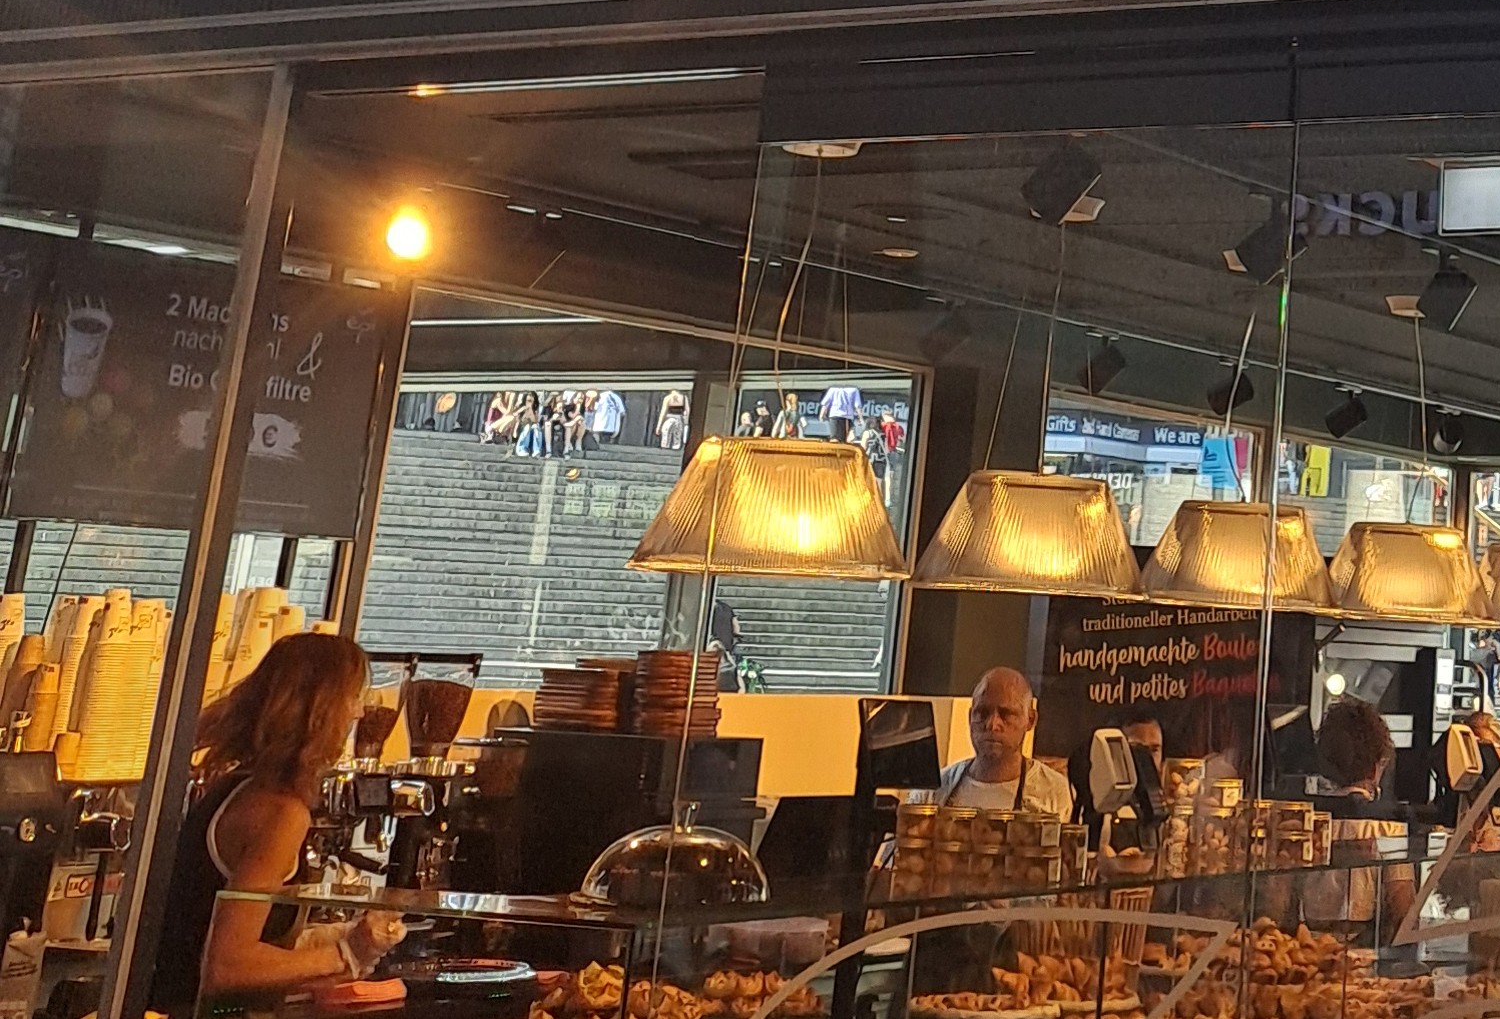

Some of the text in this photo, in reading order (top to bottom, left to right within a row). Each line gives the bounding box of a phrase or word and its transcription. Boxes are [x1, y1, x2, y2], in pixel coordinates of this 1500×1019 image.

[166, 293, 182, 316] 2
[173, 330, 224, 352] nach
[168, 364, 204, 389] Bio
[266, 376, 312, 402] filtre
[1047, 415, 1077, 432] Gifts
[1154, 427, 1201, 445] We are
[1082, 610, 1174, 632] traditioneller
[1059, 632, 1259, 677] handgemachte Boule
[1089, 677, 1125, 704] und
[1130, 673, 1188, 704] petites
